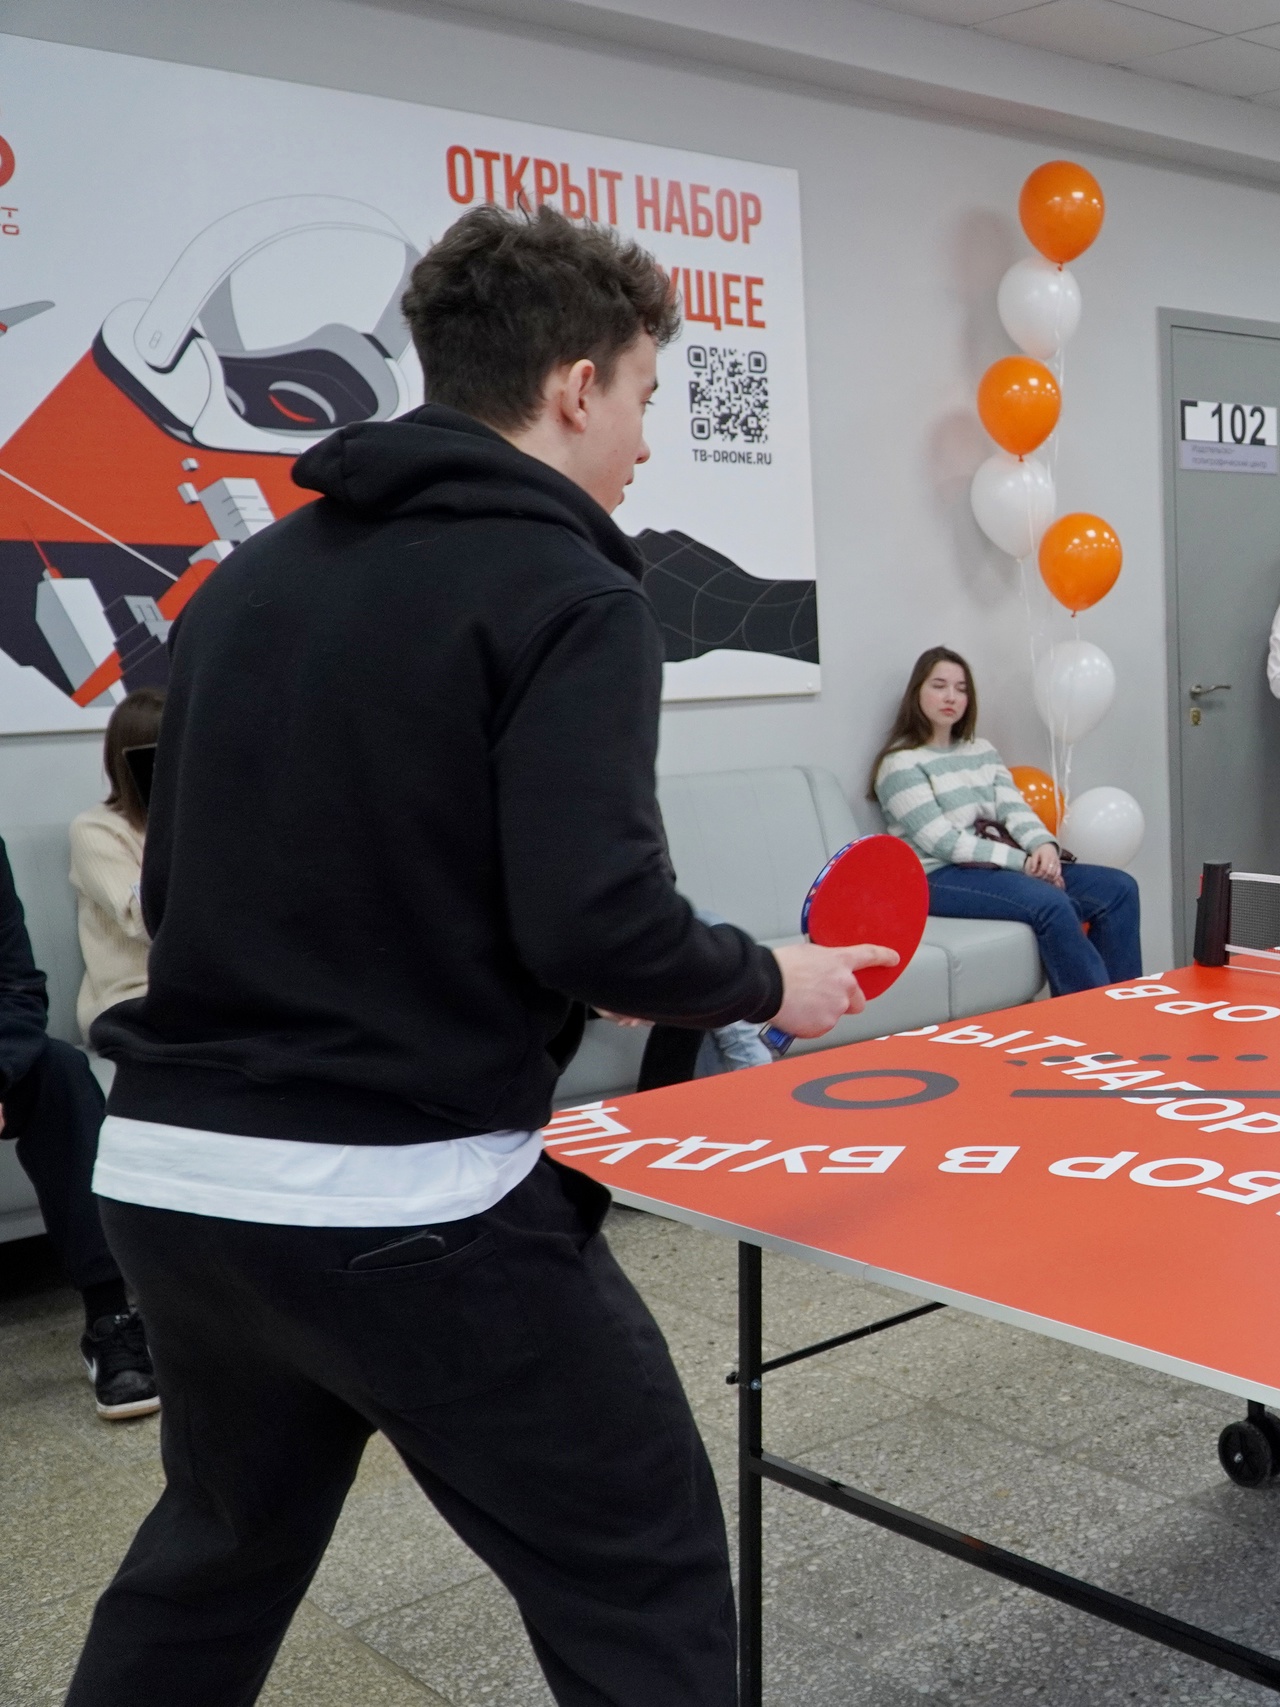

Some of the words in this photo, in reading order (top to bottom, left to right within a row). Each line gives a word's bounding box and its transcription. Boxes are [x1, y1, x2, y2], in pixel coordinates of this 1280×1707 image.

[445, 144, 623, 227] ОТКРЫТ
[634, 174, 763, 245] НАБОР
[1211, 402, 1267, 446] 102
[692, 449, 772, 465] TB-DRONE.RU
[540, 1100, 907, 1175] БУДУЩ
[937, 1145, 1021, 1174] В
